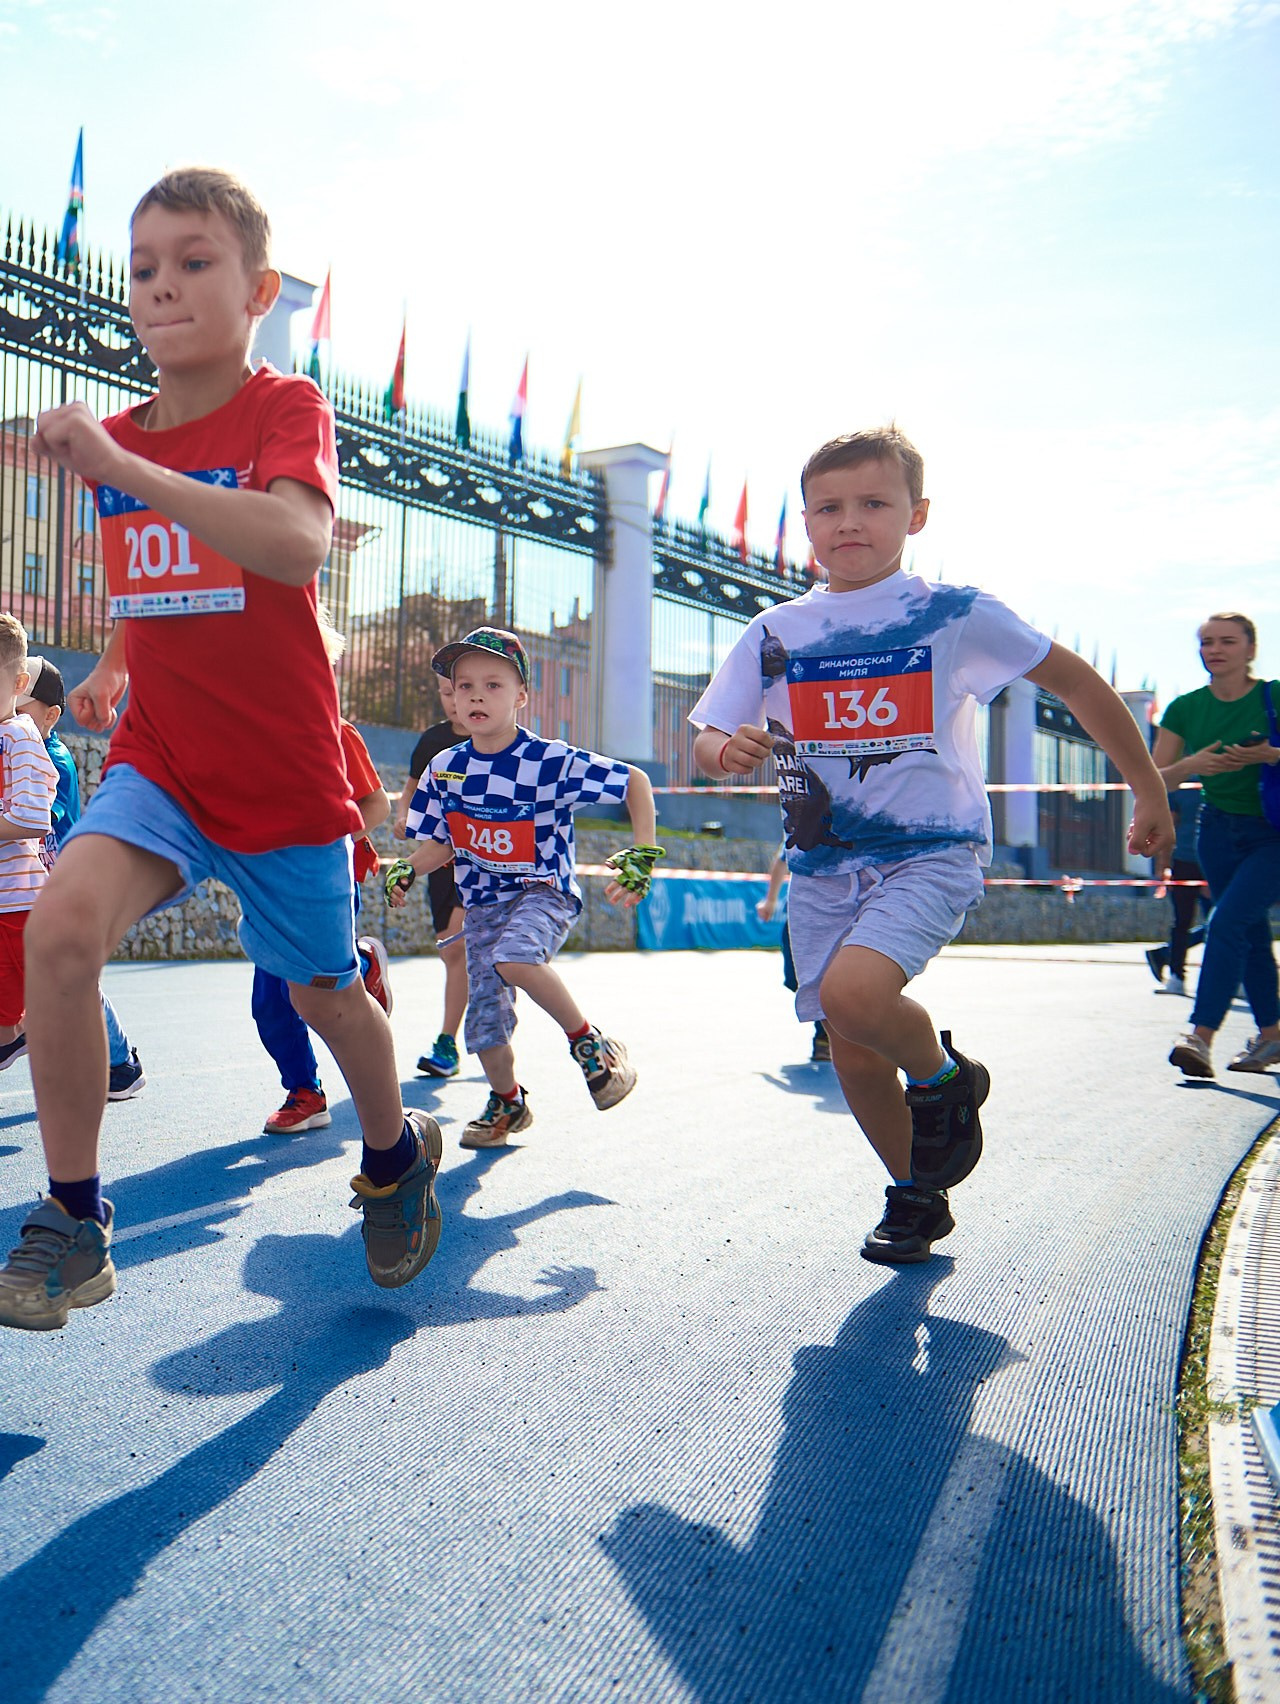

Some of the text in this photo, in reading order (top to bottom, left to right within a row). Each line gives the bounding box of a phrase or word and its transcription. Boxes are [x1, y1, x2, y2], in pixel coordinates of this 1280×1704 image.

[125, 522, 200, 579] 201
[818, 654, 893, 670] ДИНАМОВСКАЯ
[839, 668, 868, 678] МИЛЯ
[822, 687, 899, 729] 136
[462, 803, 509, 814] ДИНАМОВСКАЯ
[474, 812, 493, 820] МИЛЯ
[466, 823, 514, 855] 248
